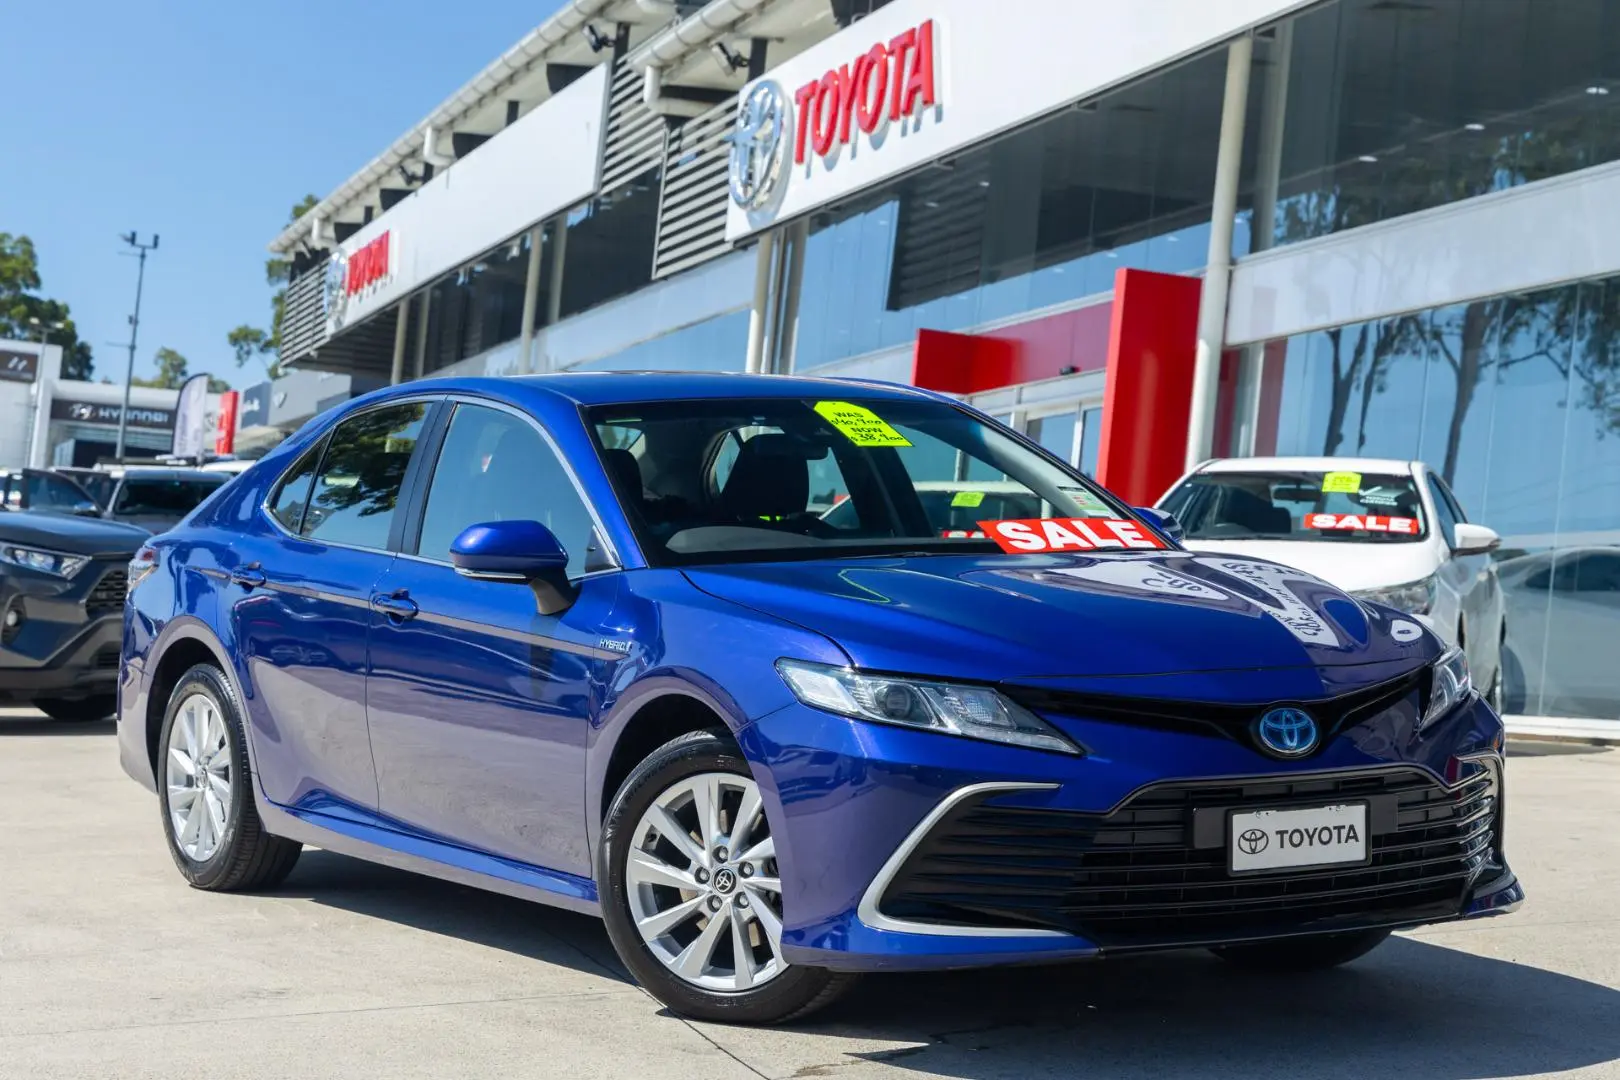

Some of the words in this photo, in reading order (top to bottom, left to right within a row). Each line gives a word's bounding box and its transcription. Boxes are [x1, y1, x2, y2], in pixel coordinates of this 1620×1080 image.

[795, 18, 935, 165] TOYOTA
[346, 230, 390, 298] TOYOTA
[833, 411, 864, 419] WAS
[996, 520, 1157, 550] SALE
[1311, 514, 1412, 533] SALE
[600, 638, 626, 651] HYBRID
[1275, 824, 1360, 849] TOYOTA
